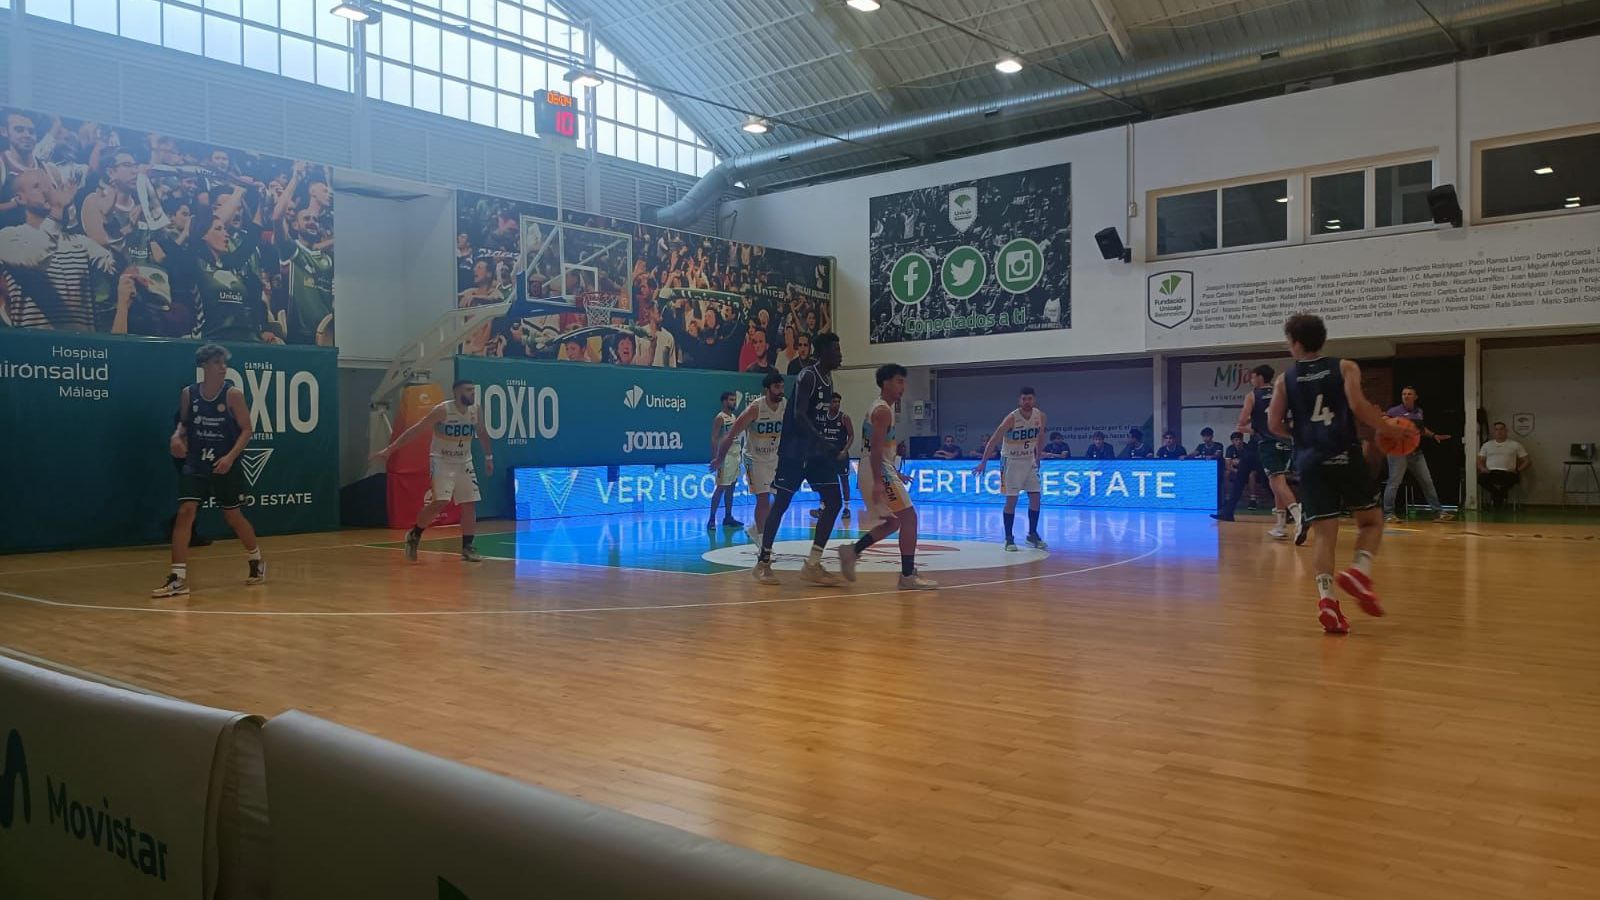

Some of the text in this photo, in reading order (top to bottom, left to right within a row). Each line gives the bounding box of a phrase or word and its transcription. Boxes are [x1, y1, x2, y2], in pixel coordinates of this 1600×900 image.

[555, 110, 574, 136] 10
[1446, 269, 1466, 277] Miguel
[1527, 262, 1549, 270] Miguel
[905, 306, 1026, 334] Conectados a ti
[52, 345, 108, 360] Hospital
[0, 360, 108, 380] irónsalud
[245, 362, 272, 370] CAMPAÑA
[1214, 363, 1252, 392] Mija
[59, 386, 109, 400] Málaga
[646, 394, 686, 412] Unicaja
[1310, 394, 1335, 426] 4
[758, 422, 782, 434] CBC
[458, 440, 464, 448] 4
[202, 448, 215, 461] 14
[596, 470, 716, 504] VERTIGO
[1043, 471, 1176, 499] ESTATE
[261, 492, 312, 506] ESTATE
[47, 774, 168, 881] Movistar
